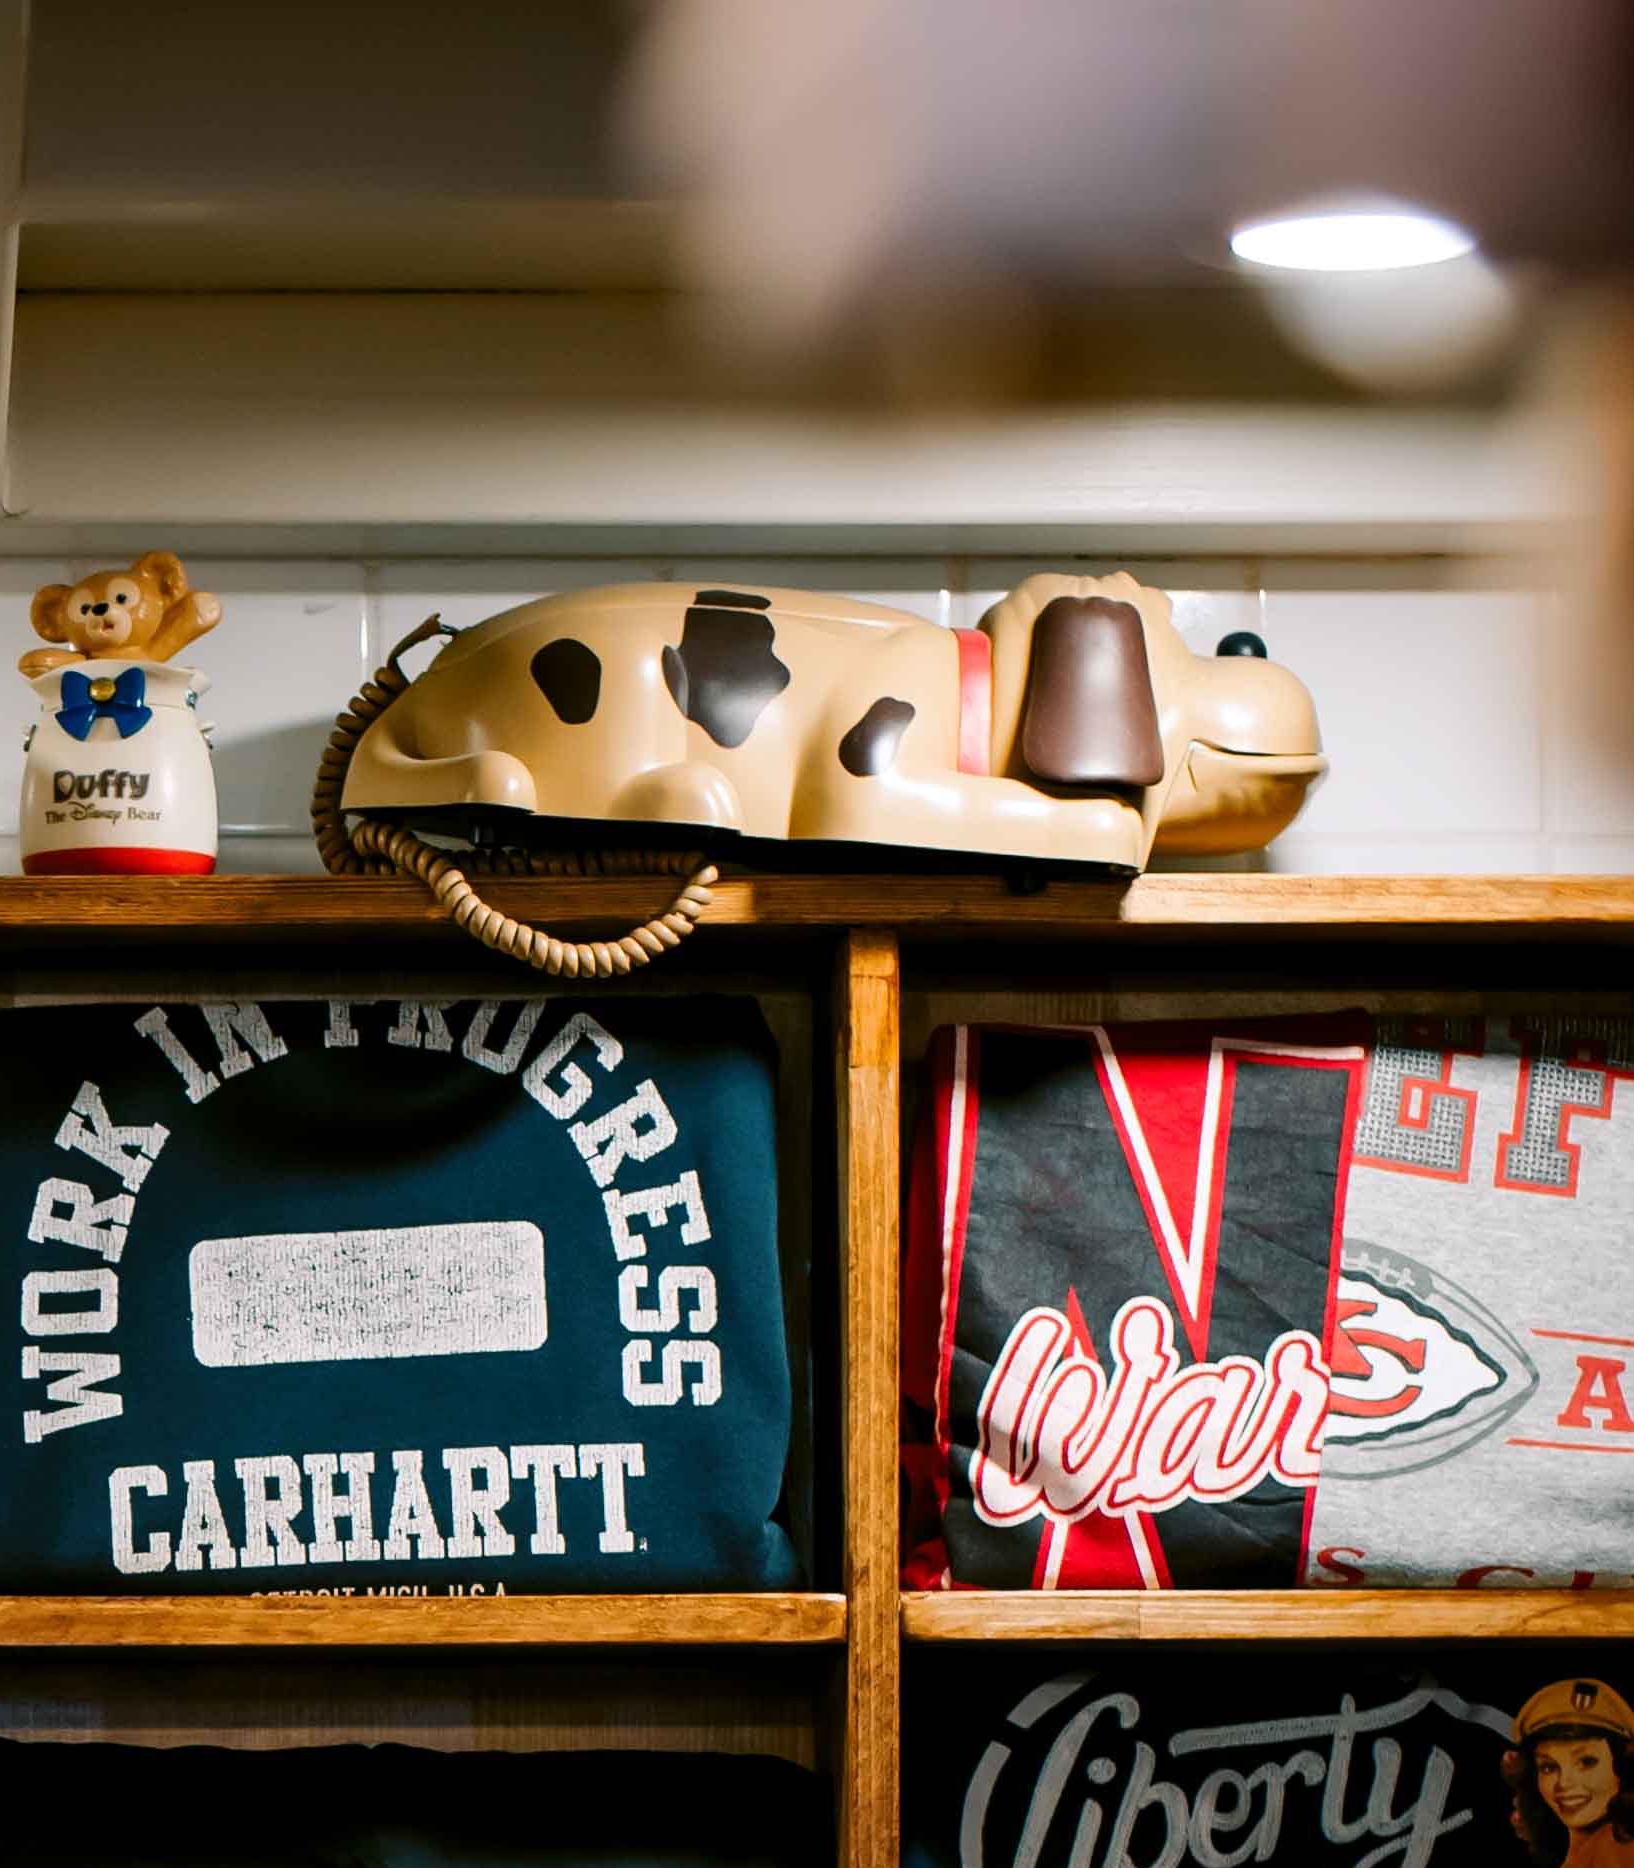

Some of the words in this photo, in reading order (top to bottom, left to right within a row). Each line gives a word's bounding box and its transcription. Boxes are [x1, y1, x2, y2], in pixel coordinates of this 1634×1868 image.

[53, 769, 150, 804] Duffy
[21, 1080, 170, 1444] WORK
[133, 1001, 289, 1105] IN
[108, 1443, 648, 1575] CARHARTT
